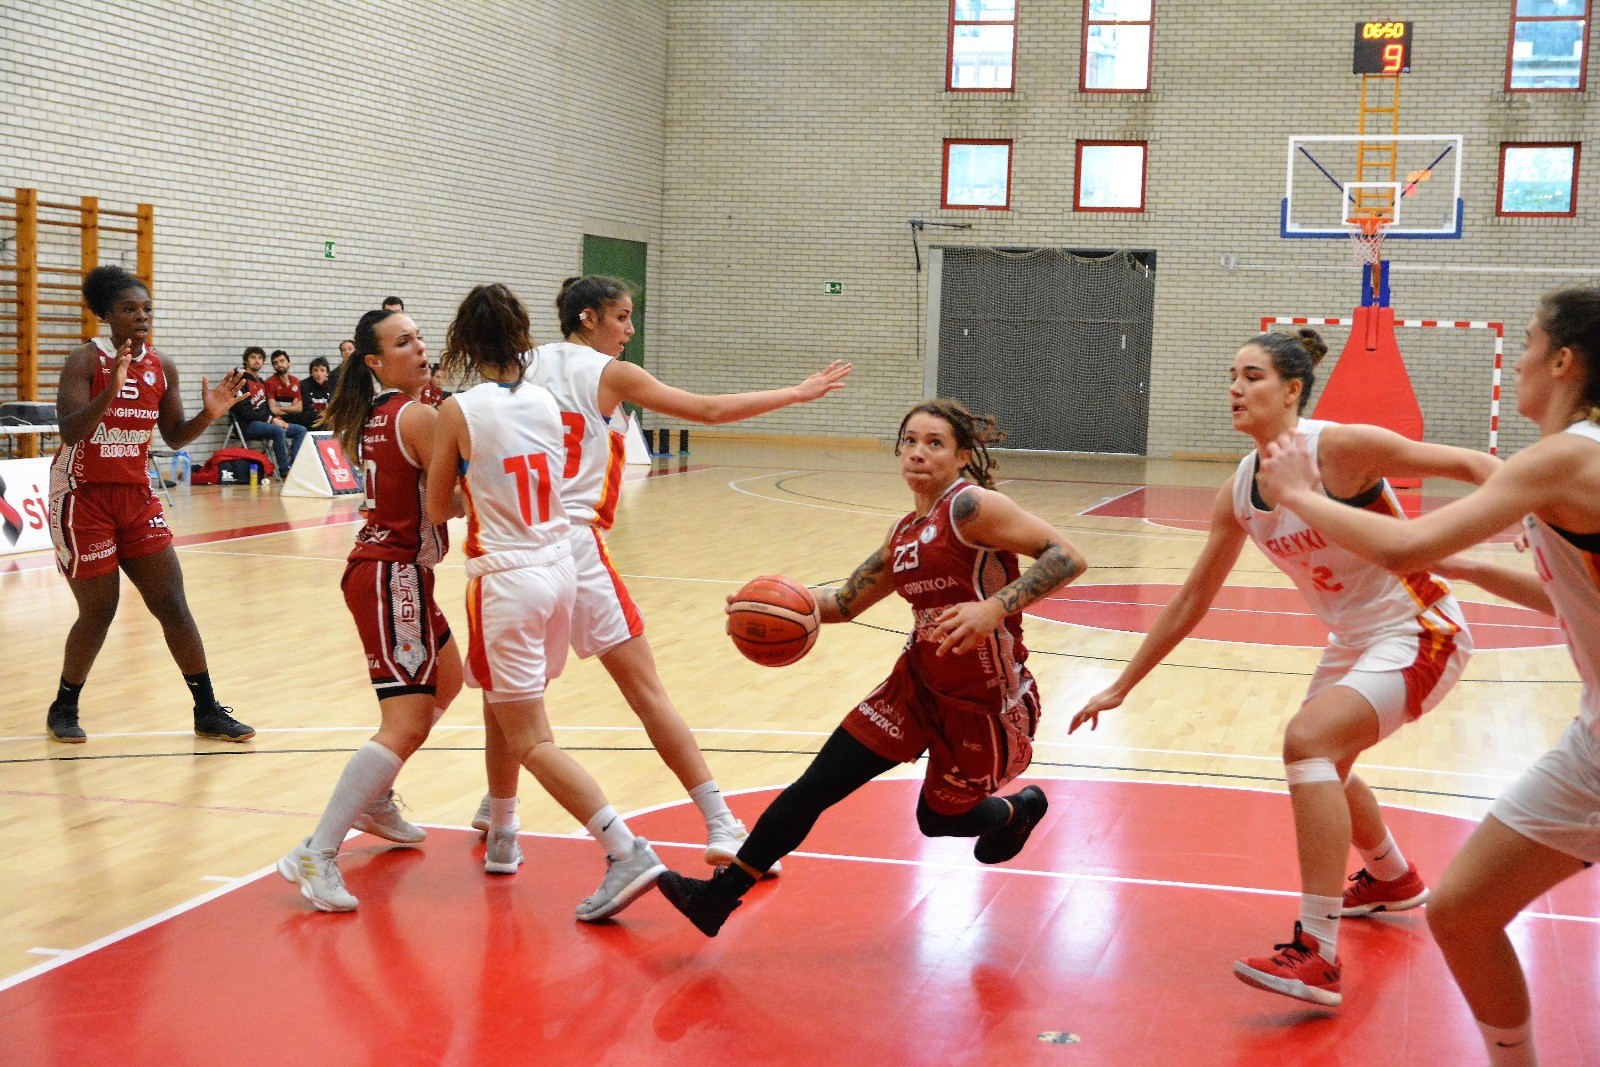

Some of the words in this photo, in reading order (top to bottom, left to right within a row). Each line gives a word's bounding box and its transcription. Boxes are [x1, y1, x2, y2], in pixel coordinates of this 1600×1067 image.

[1383, 44, 1403, 71] 9
[503, 452, 551, 526] 11
[892, 540, 919, 573] 23
